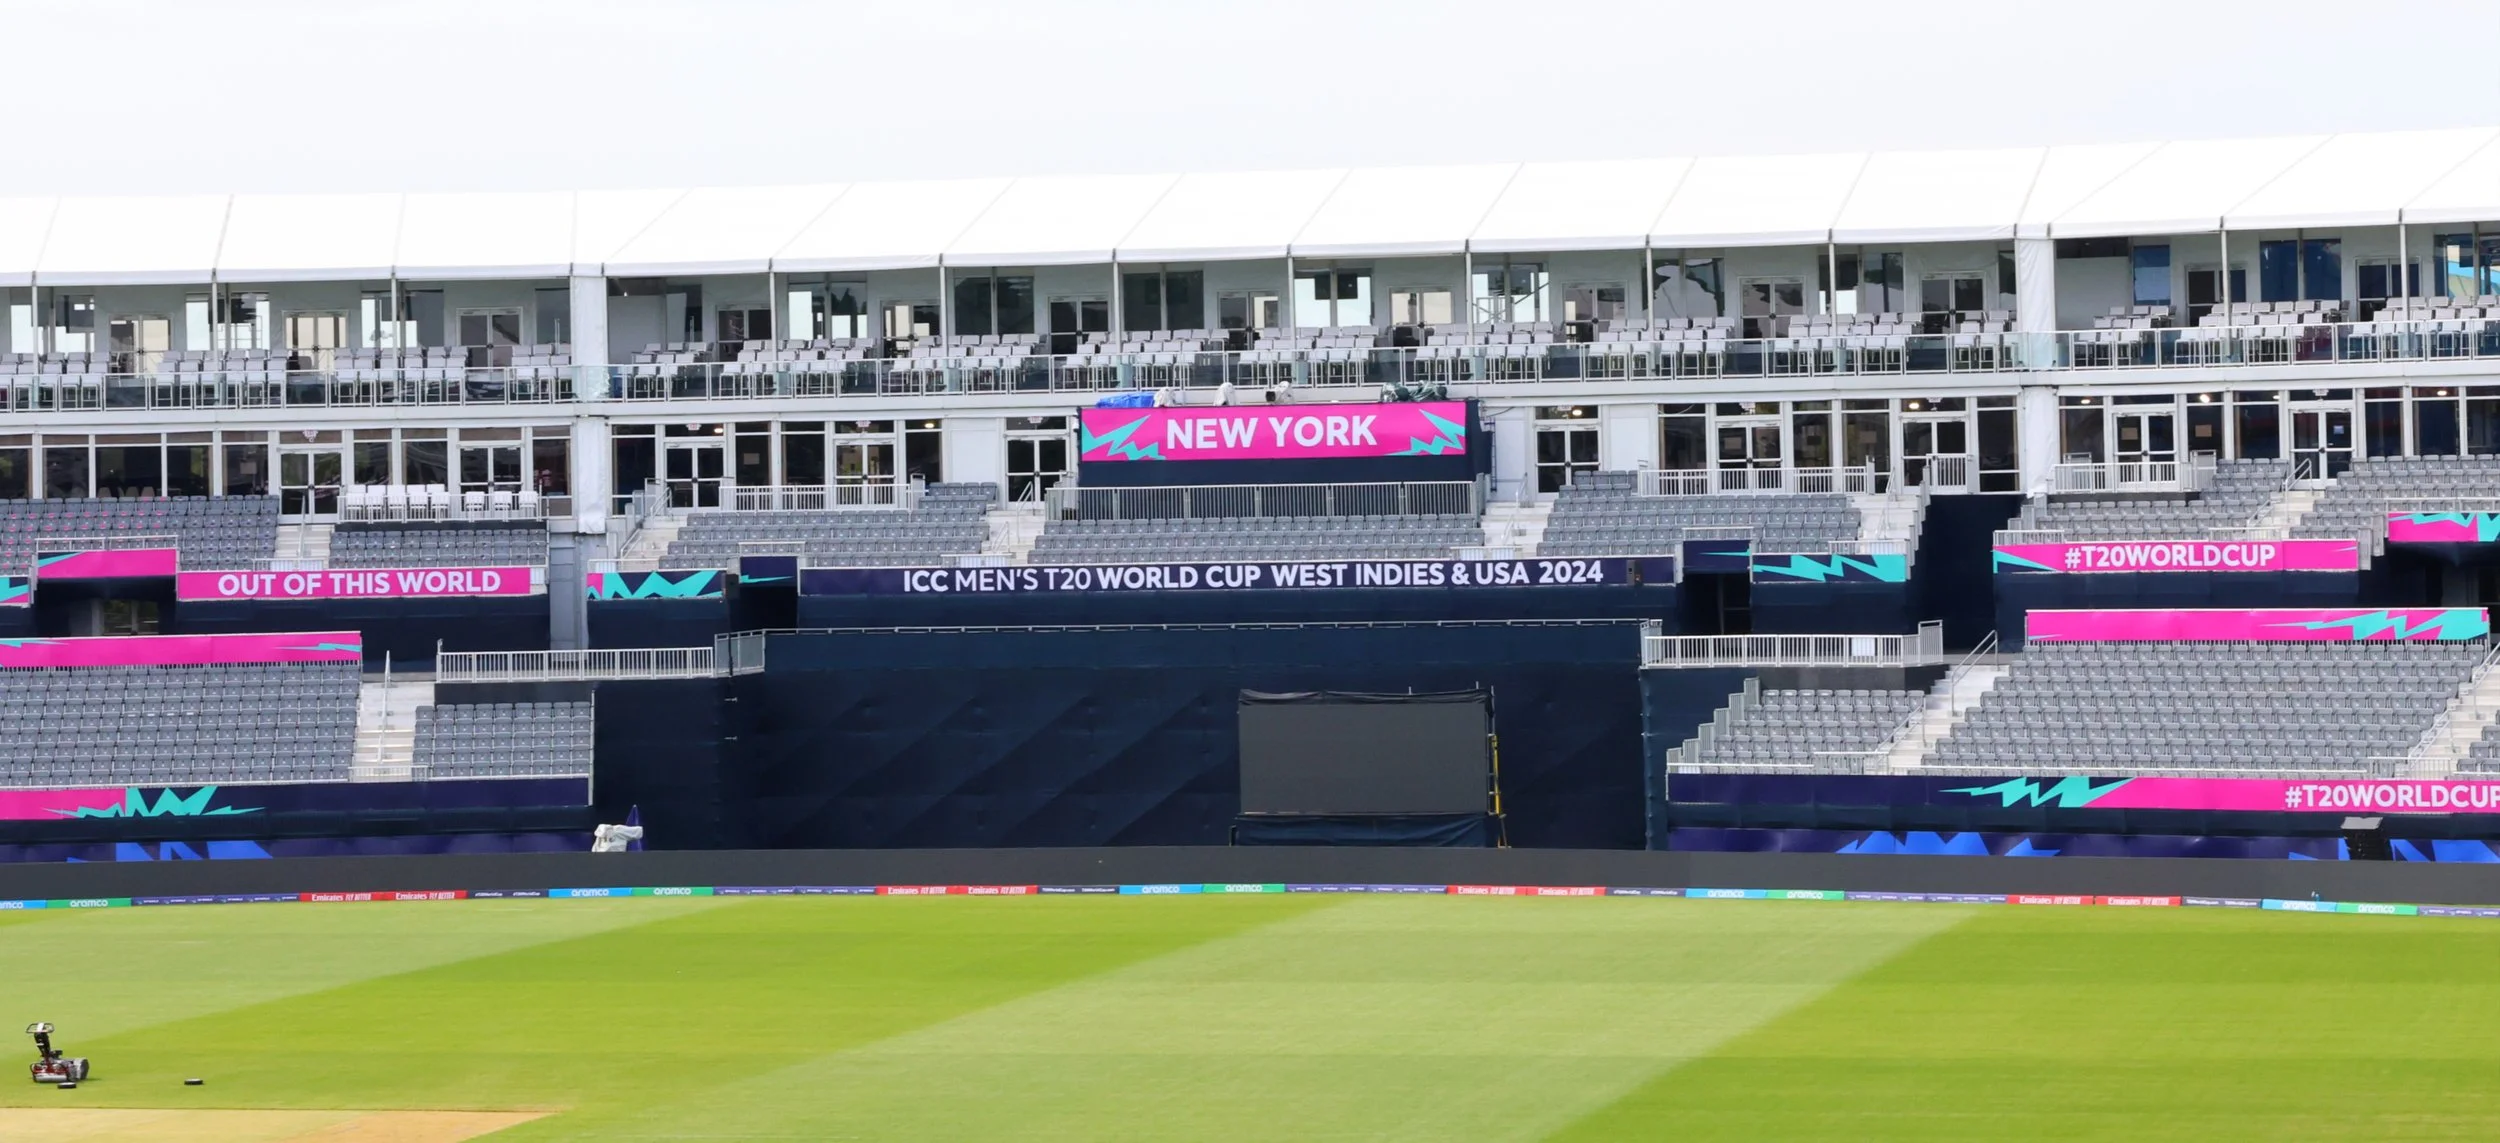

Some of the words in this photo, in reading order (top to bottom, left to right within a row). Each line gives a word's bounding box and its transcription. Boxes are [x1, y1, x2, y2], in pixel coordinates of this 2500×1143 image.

[1167, 418, 1258, 448] NEW
[1269, 415, 1376, 446] YORK
[2065, 545, 2275, 568] #T20WORLDCUP
[904, 570, 948, 591] ICC
[956, 567, 1038, 591] MEN'S
[1044, 568, 1091, 589] T20
[1096, 567, 1198, 589] WORLD
[1206, 565, 1260, 587] CUP
[1271, 564, 1347, 586] WEST
[1356, 563, 1444, 585] INDIES
[1452, 563, 1470, 584] &
[1476, 562, 1529, 584] USA
[1539, 560, 1603, 583] 2024
[219, 574, 276, 595] OUT
[284, 574, 321, 594] OF
[329, 573, 390, 594] THIS
[397, 571, 500, 592] WORLD
[571, 888, 609, 897] aramco
[654, 887, 692, 896] aramco
[1142, 885, 1180, 894] aramco
[1225, 884, 1263, 893] aramco
[70, 899, 108, 908] aramco
